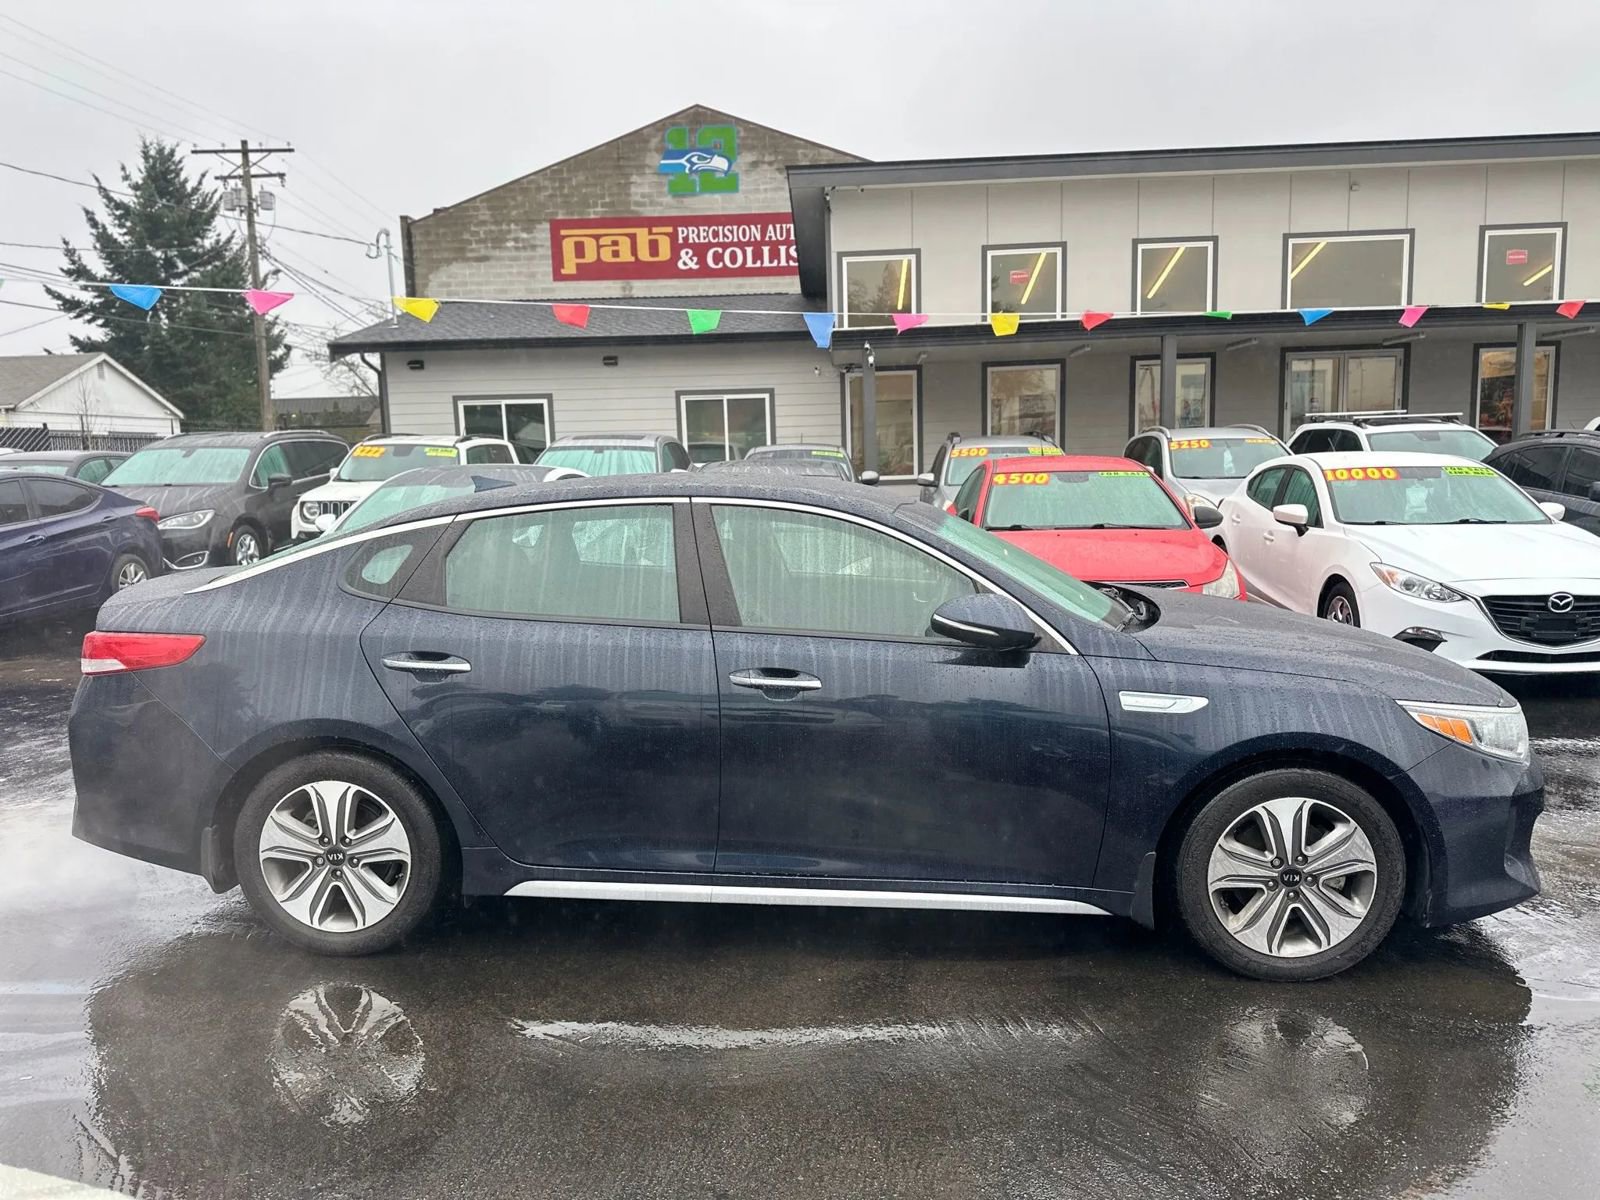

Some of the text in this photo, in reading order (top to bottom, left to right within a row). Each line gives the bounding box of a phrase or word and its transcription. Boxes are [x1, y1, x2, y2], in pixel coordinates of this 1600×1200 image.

[677, 225, 761, 244] PRECISION
[560, 226, 673, 275] pab
[677, 248, 700, 270] &
[1169, 439, 1209, 450] 5250
[950, 447, 988, 458] 5500
[993, 473, 1049, 485] 4500
[1325, 467, 1398, 481] 10000
